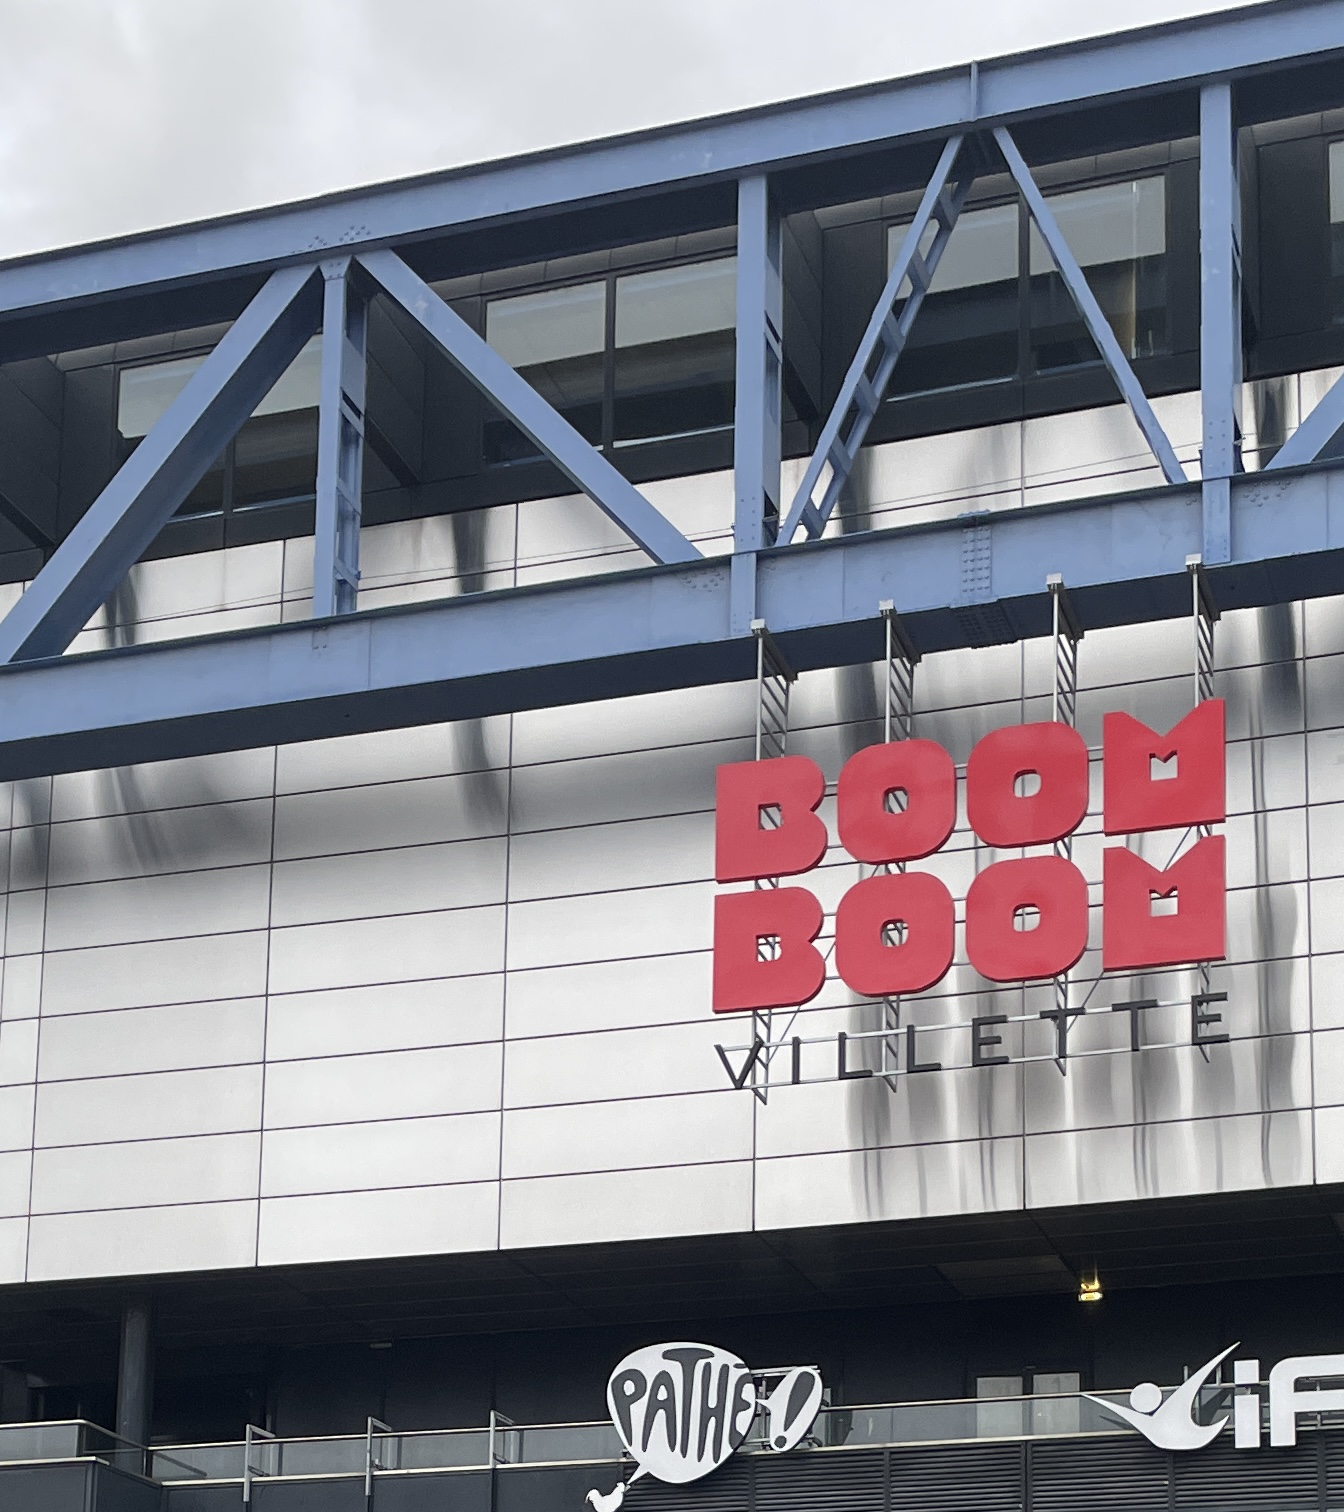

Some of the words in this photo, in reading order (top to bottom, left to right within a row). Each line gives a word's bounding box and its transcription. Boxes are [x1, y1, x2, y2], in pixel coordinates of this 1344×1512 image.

[715, 698, 1226, 883] BOOM
[712, 834, 1226, 1013] BOOM
[714, 992, 1230, 1089] VILLETTE
